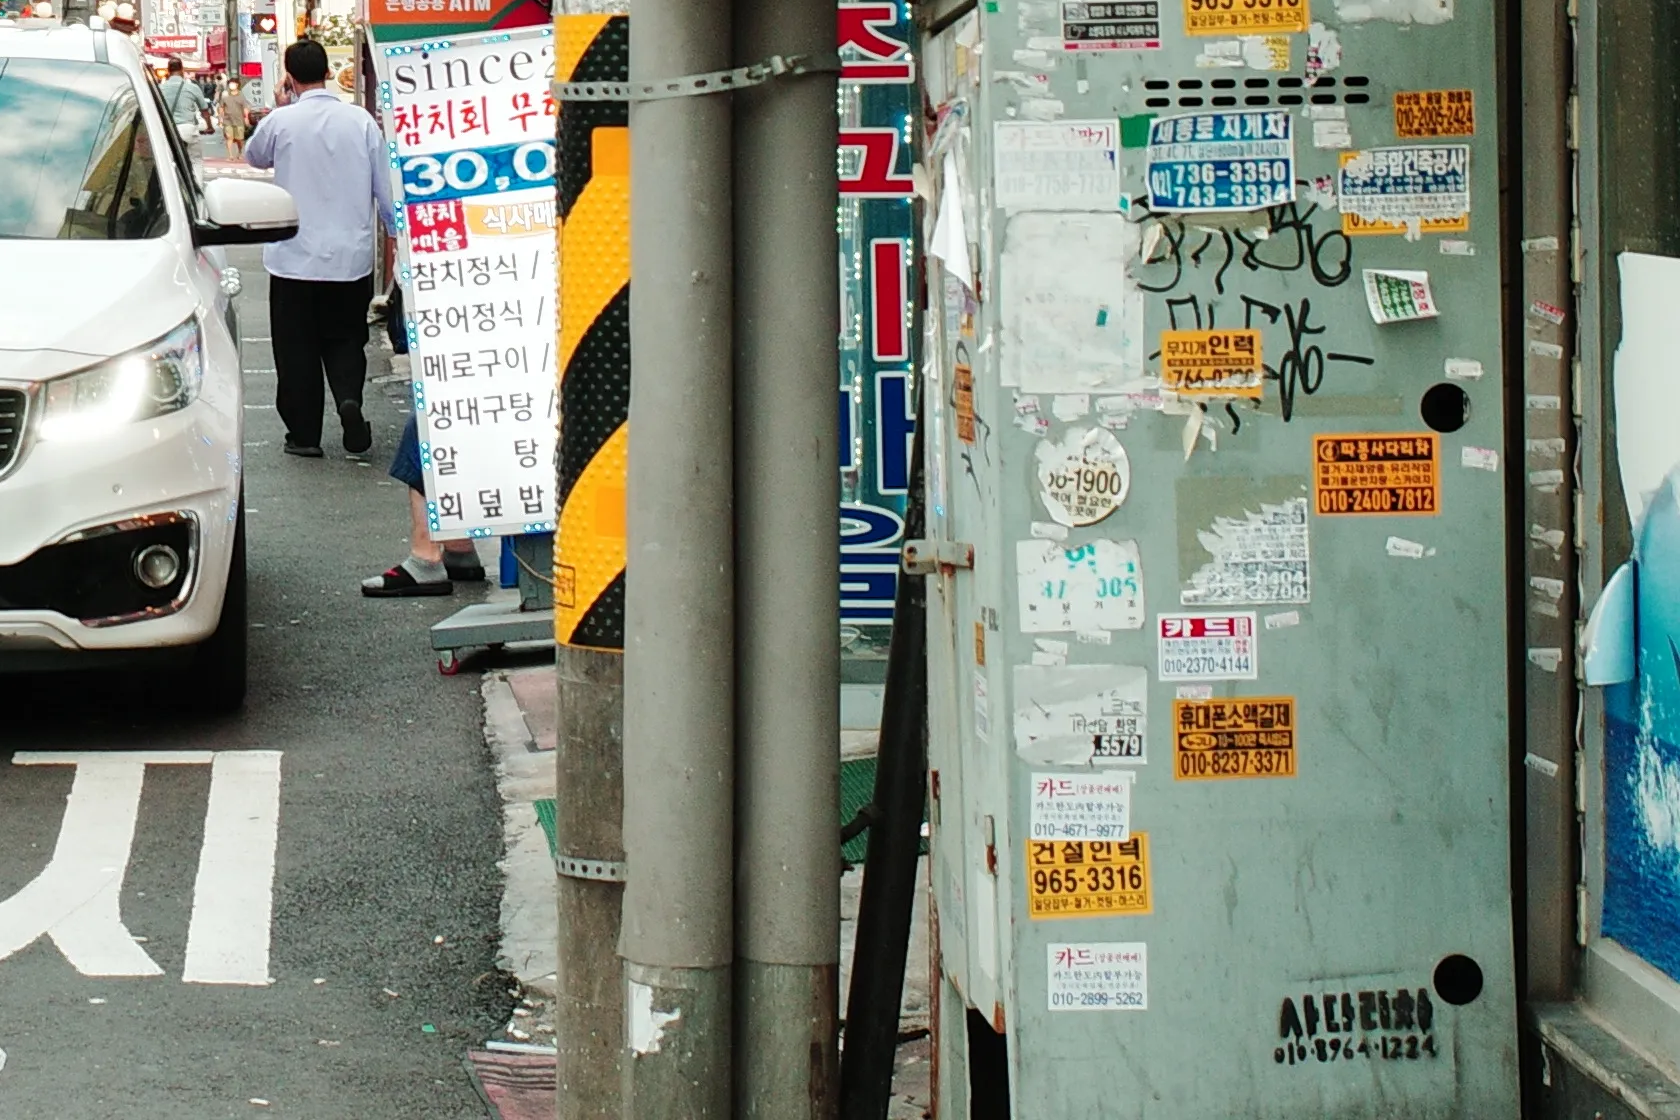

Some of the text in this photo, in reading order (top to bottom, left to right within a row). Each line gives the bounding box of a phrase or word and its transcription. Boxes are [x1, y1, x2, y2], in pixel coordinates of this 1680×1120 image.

[418, 299, 524, 339] 장어정식
[422, 345, 529, 383] 메로구이
[427, 392, 535, 430] 생대구탕
[1036, 777, 1076, 800] 카드
[1033, 865, 1142, 896] 965-3316
[1054, 947, 1095, 969] 카드
